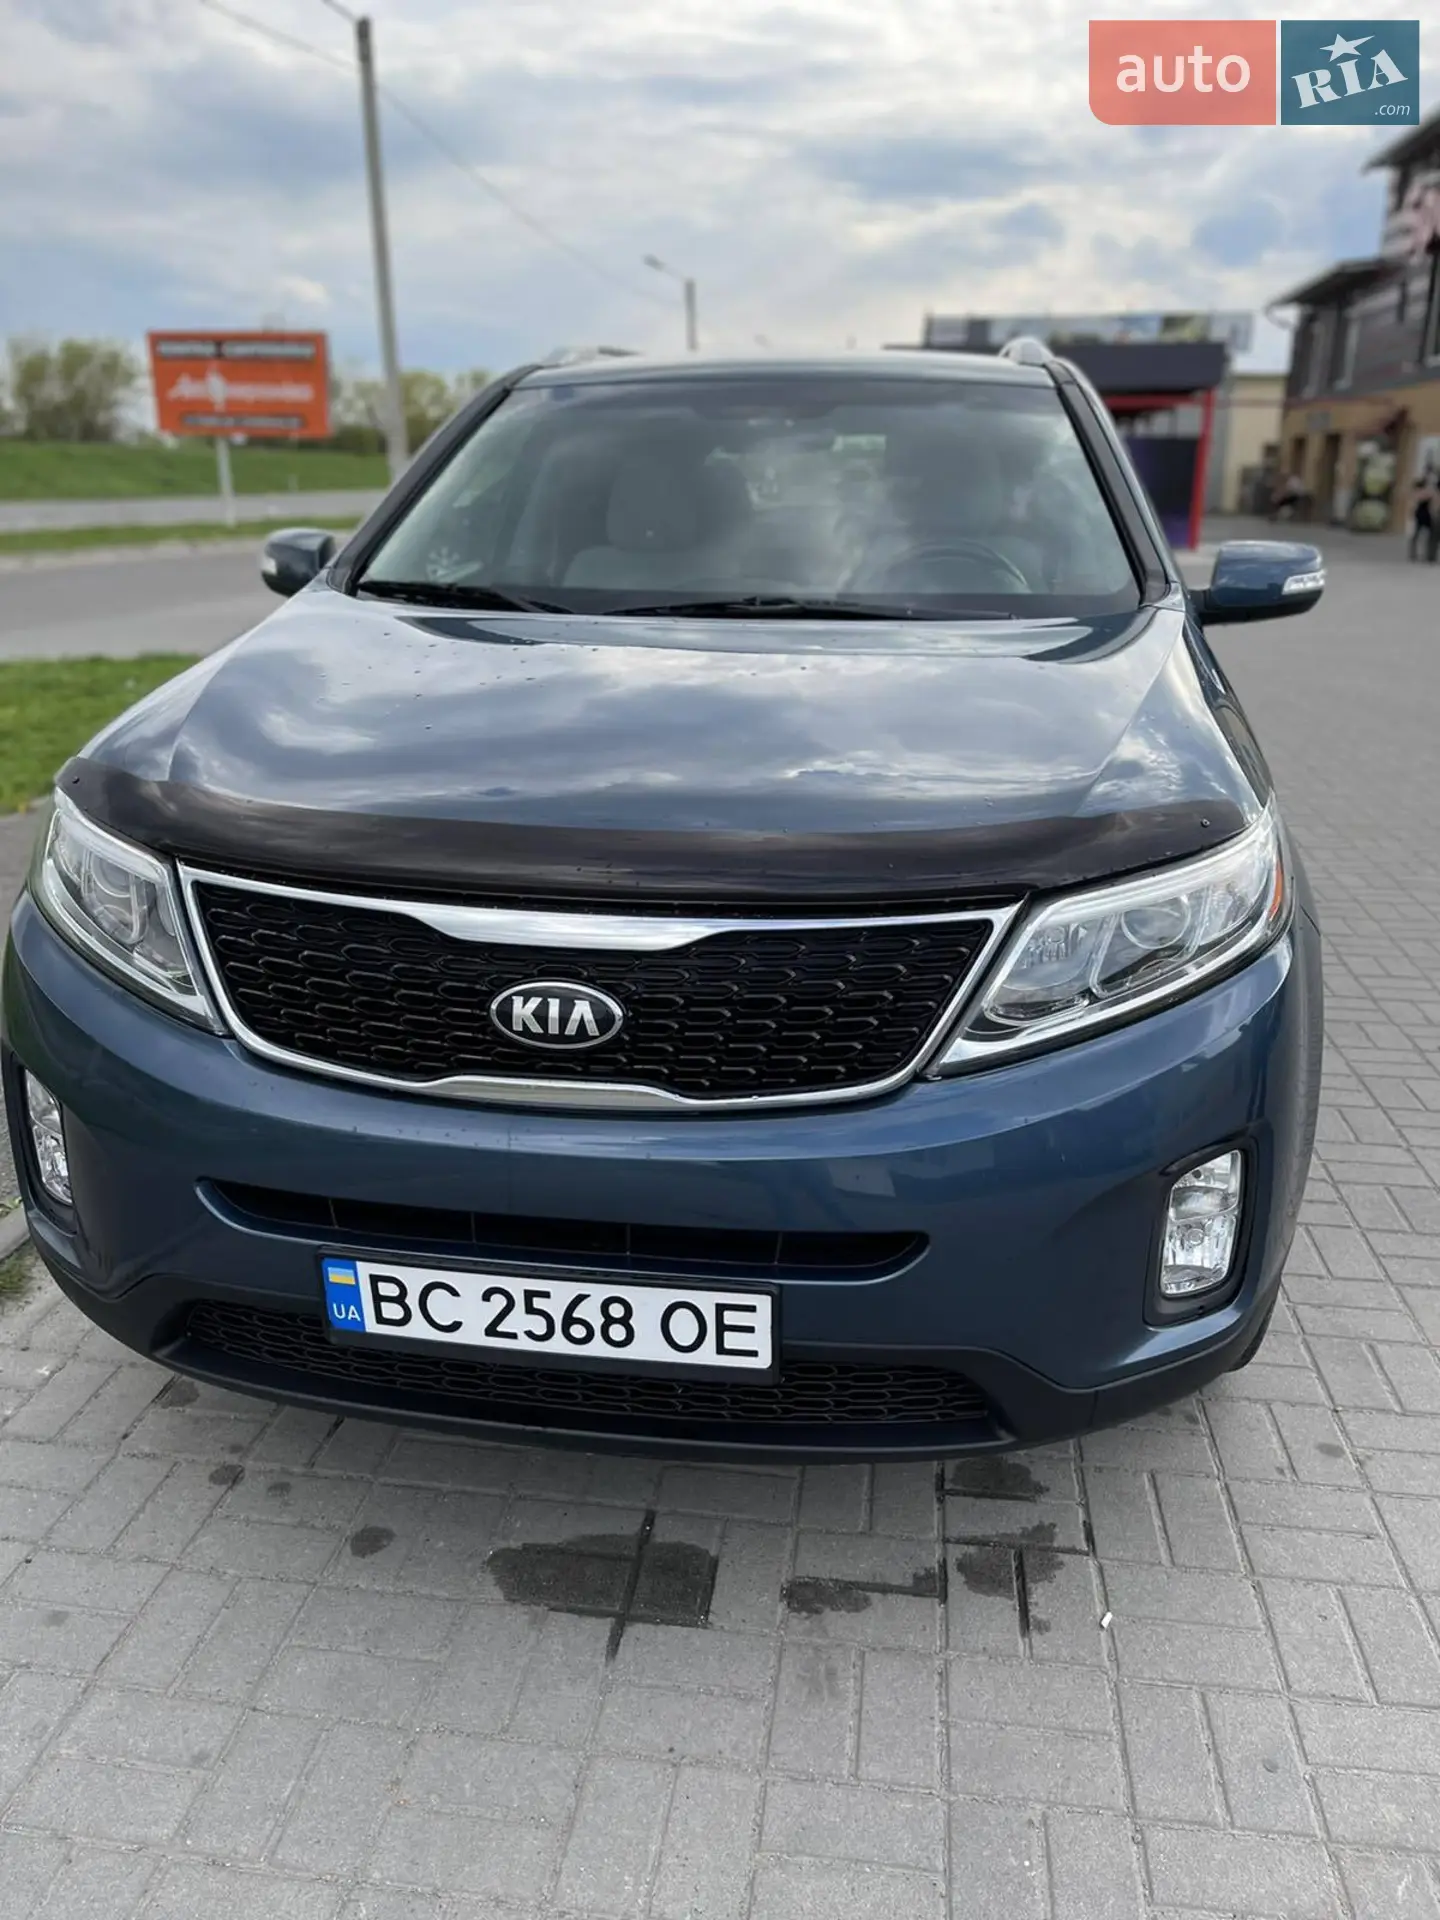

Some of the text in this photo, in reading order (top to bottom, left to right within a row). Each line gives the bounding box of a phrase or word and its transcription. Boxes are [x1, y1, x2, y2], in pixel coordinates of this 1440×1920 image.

[511, 995, 600, 1036] KIA
[333, 1301, 361, 1322] UA
[368, 1273, 759, 1357] BC 2568 OE
